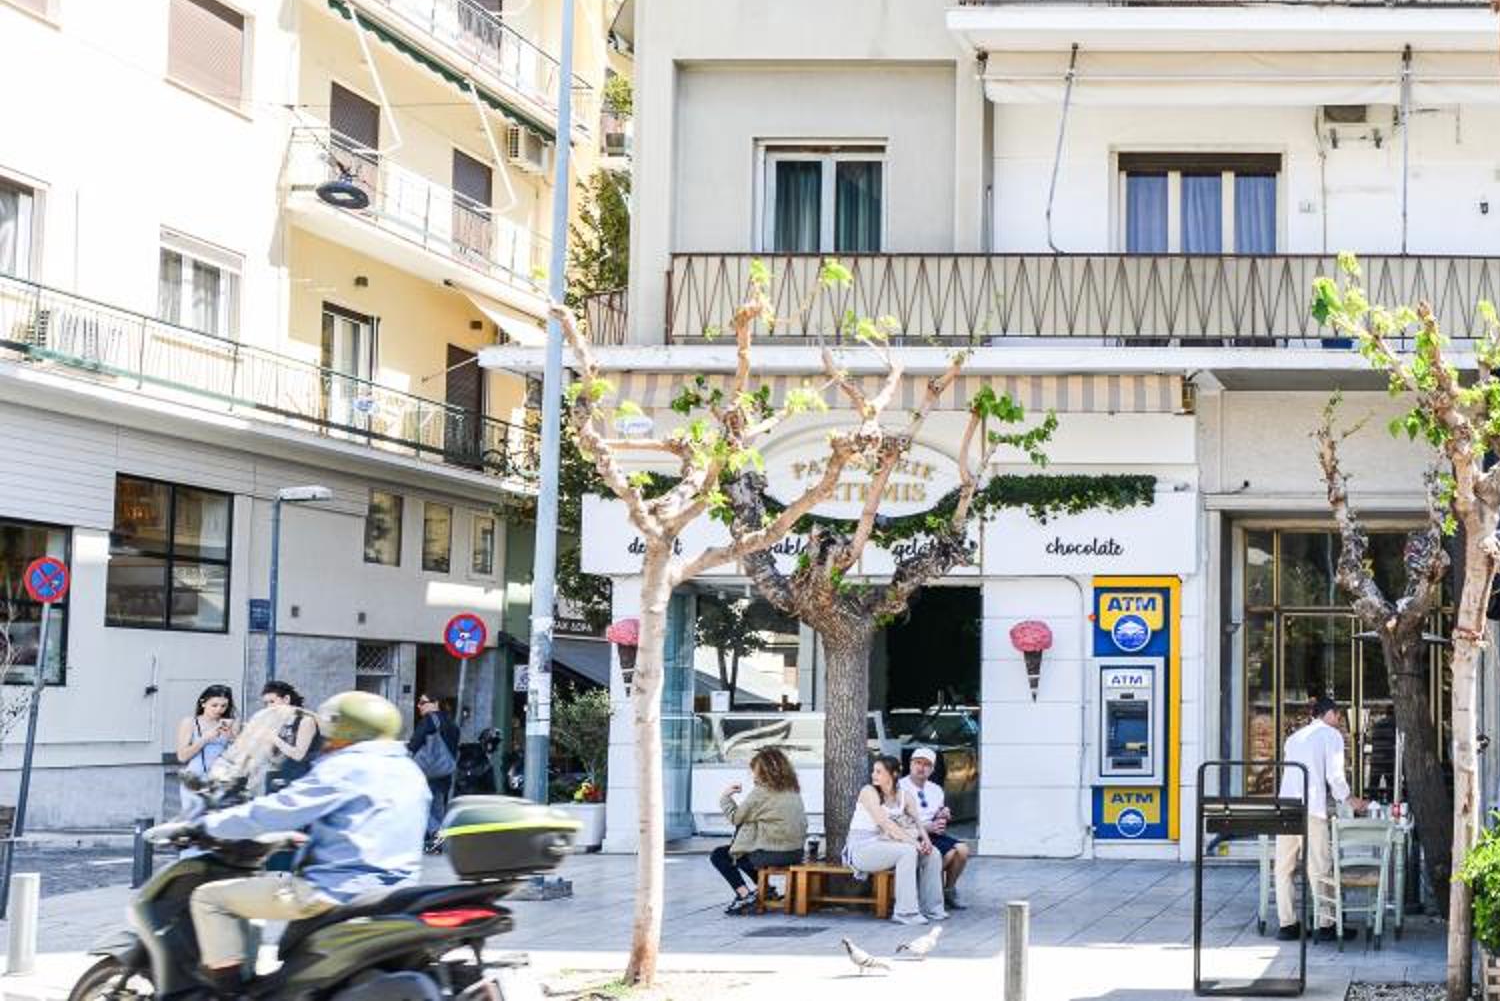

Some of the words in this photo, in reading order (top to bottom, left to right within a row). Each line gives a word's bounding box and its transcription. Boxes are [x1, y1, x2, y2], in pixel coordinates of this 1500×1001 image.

[1045, 536, 1125, 556] chocolate
[1107, 597, 1157, 612] ATM
[1111, 675, 1143, 685] ATM
[1111, 792, 1153, 804] ATM
